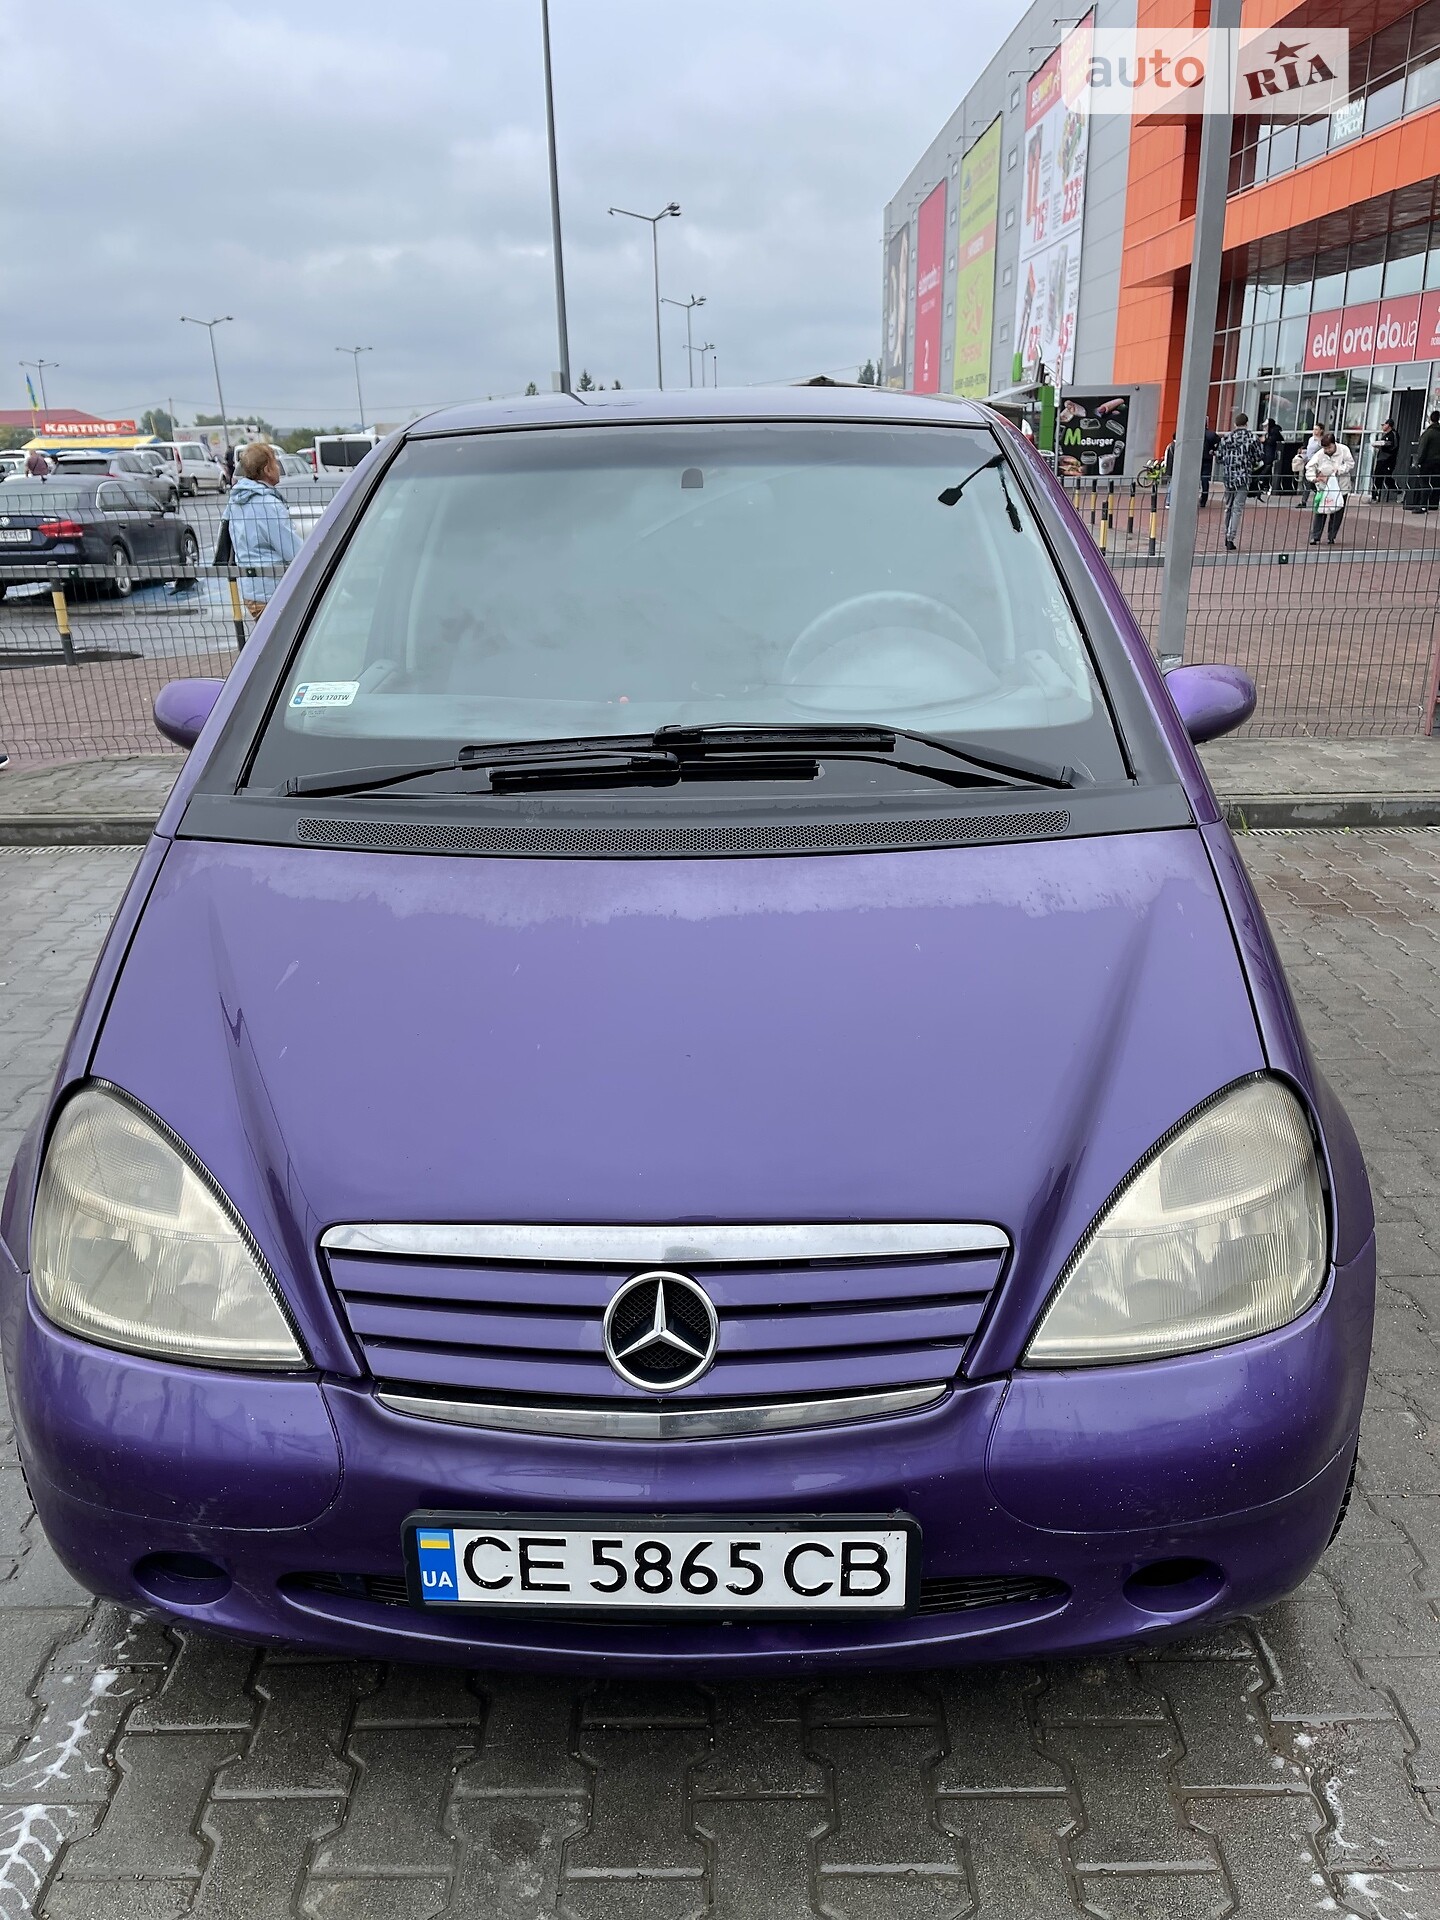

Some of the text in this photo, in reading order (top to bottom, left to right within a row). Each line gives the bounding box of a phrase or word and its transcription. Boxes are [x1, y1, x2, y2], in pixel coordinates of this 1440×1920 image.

[1313, 314, 1418, 358] eldorado.ua
[1064, 428, 1114, 447] MoBurger
[422, 1571, 453, 1588] UA
[463, 1536, 892, 1597] CE 5865 CB
